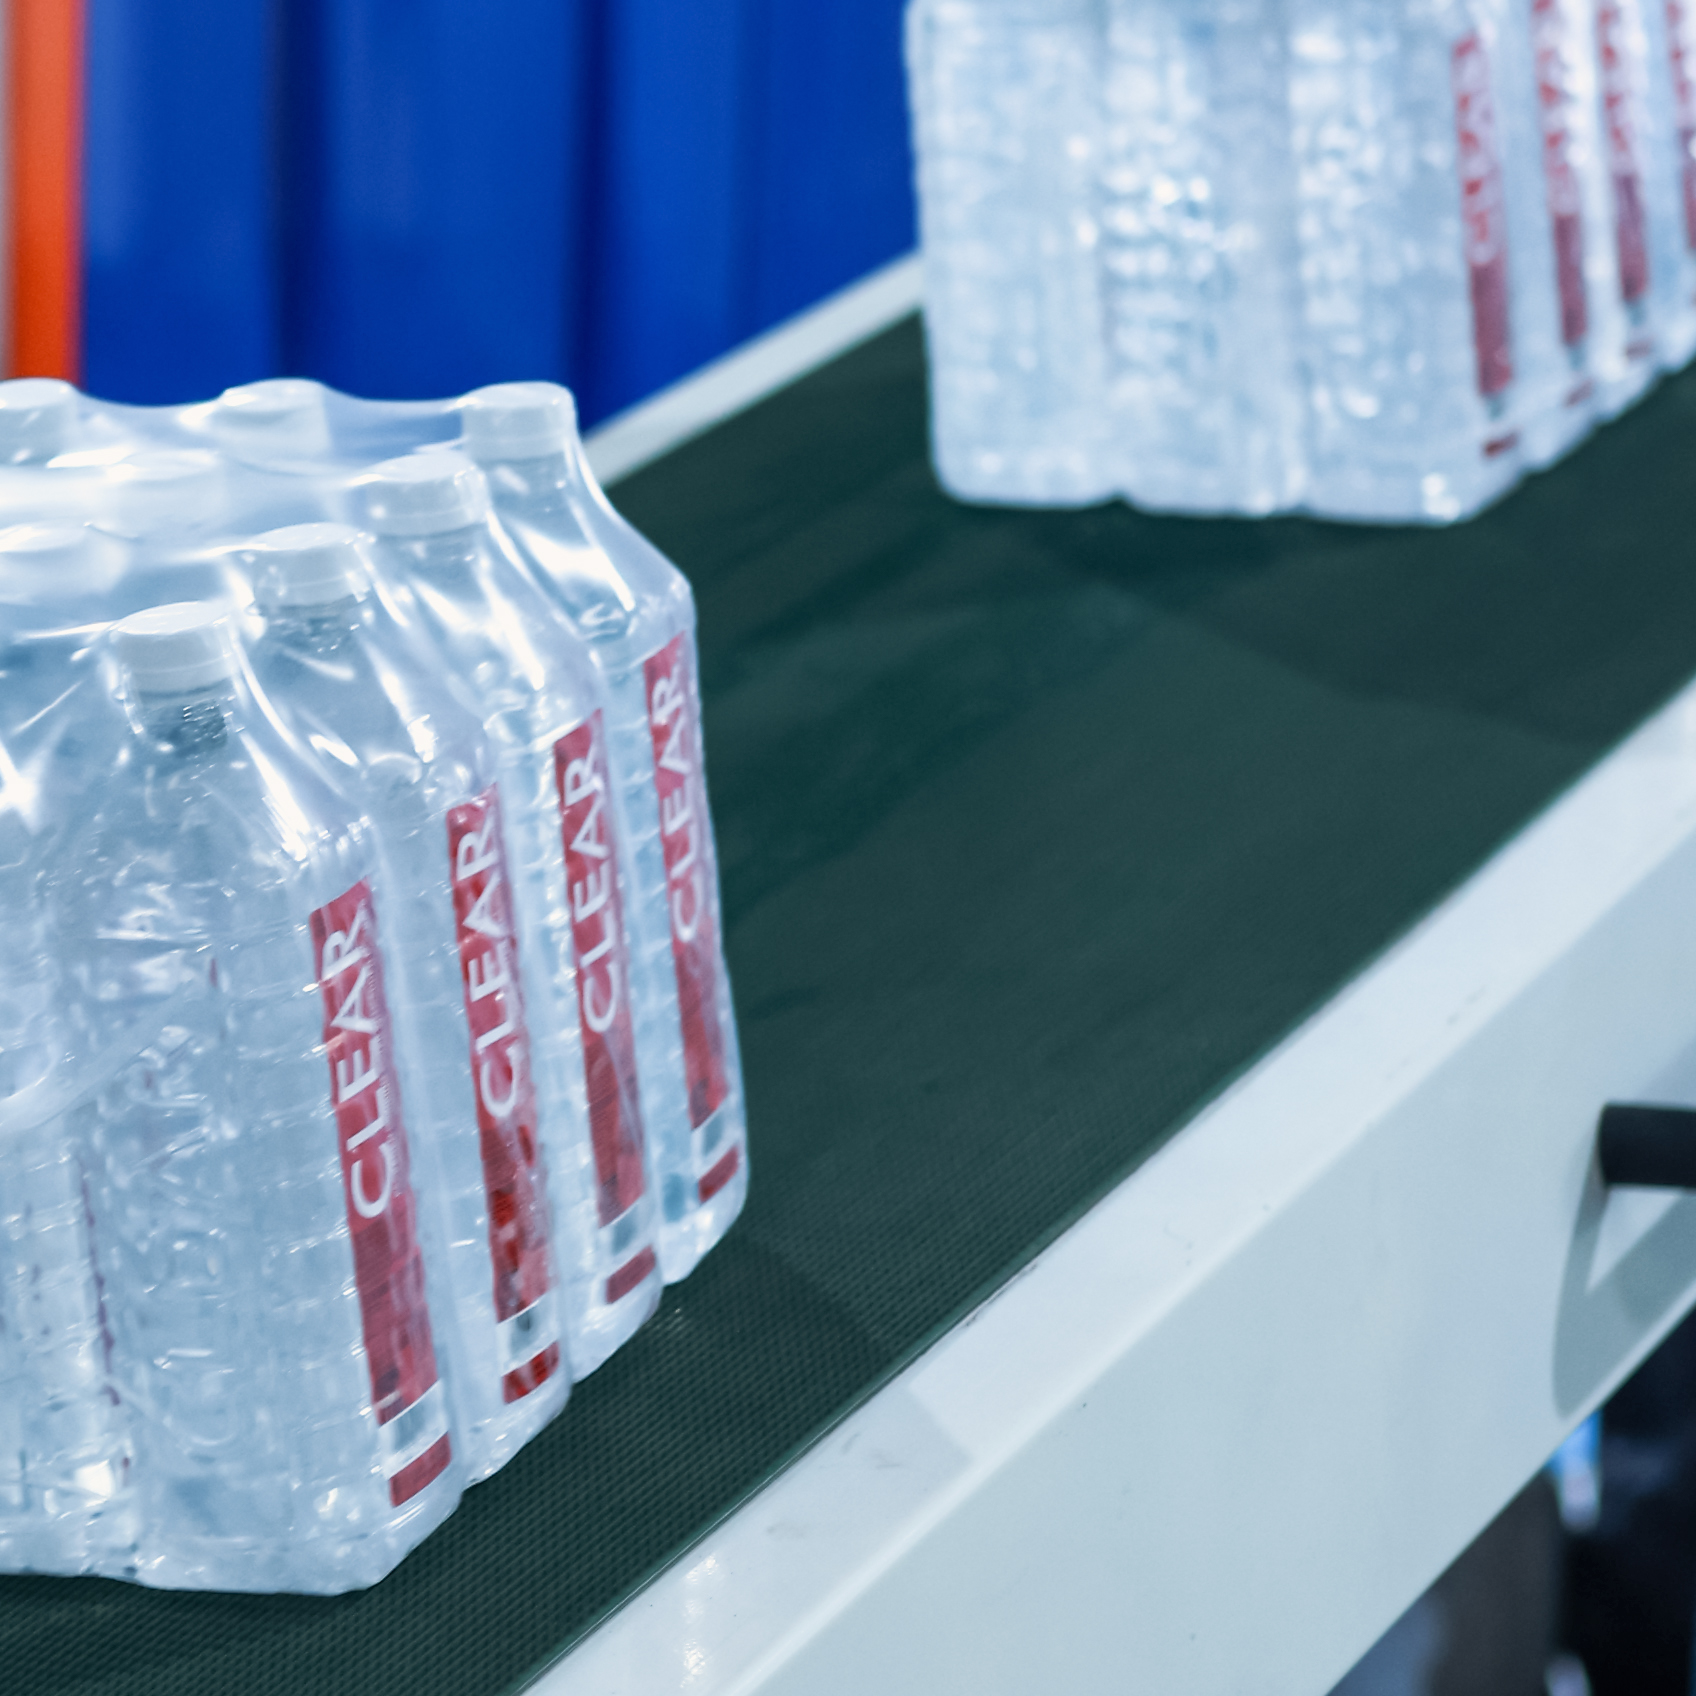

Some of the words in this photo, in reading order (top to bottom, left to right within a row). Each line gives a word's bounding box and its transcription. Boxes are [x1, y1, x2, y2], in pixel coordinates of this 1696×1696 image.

[564, 740, 619, 1033] CLEAR
[652, 664, 704, 943] CLEAR
[321, 899, 395, 1219] CLEAR
[456, 807, 521, 1118] CLEAR
